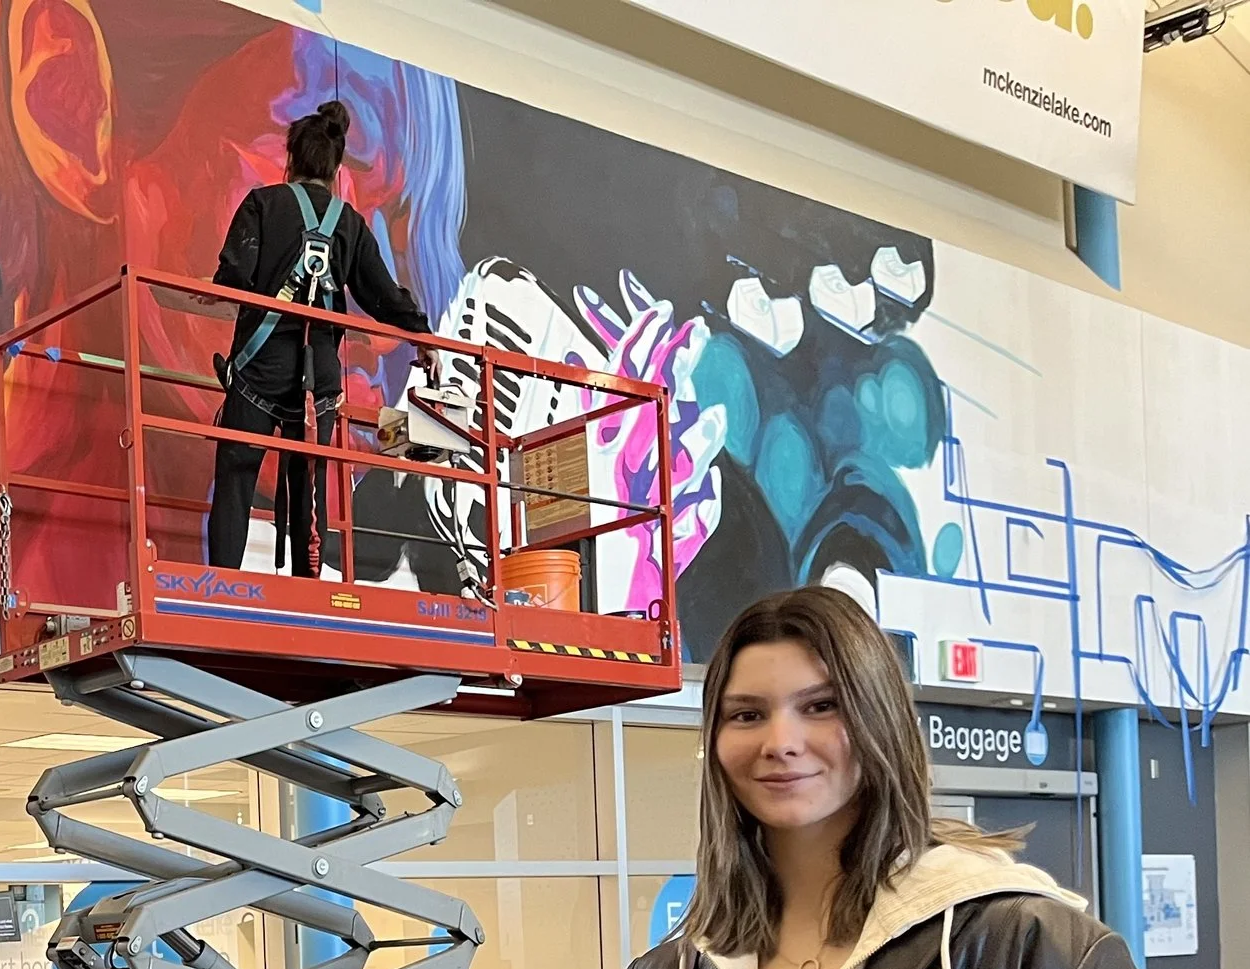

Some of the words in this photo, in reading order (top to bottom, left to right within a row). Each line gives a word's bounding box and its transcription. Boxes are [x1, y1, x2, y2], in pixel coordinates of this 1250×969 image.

[983, 67, 1112, 138] mckenzielake.com
[155, 569, 266, 601] SKYJACK
[929, 715, 1022, 762] Baggage
